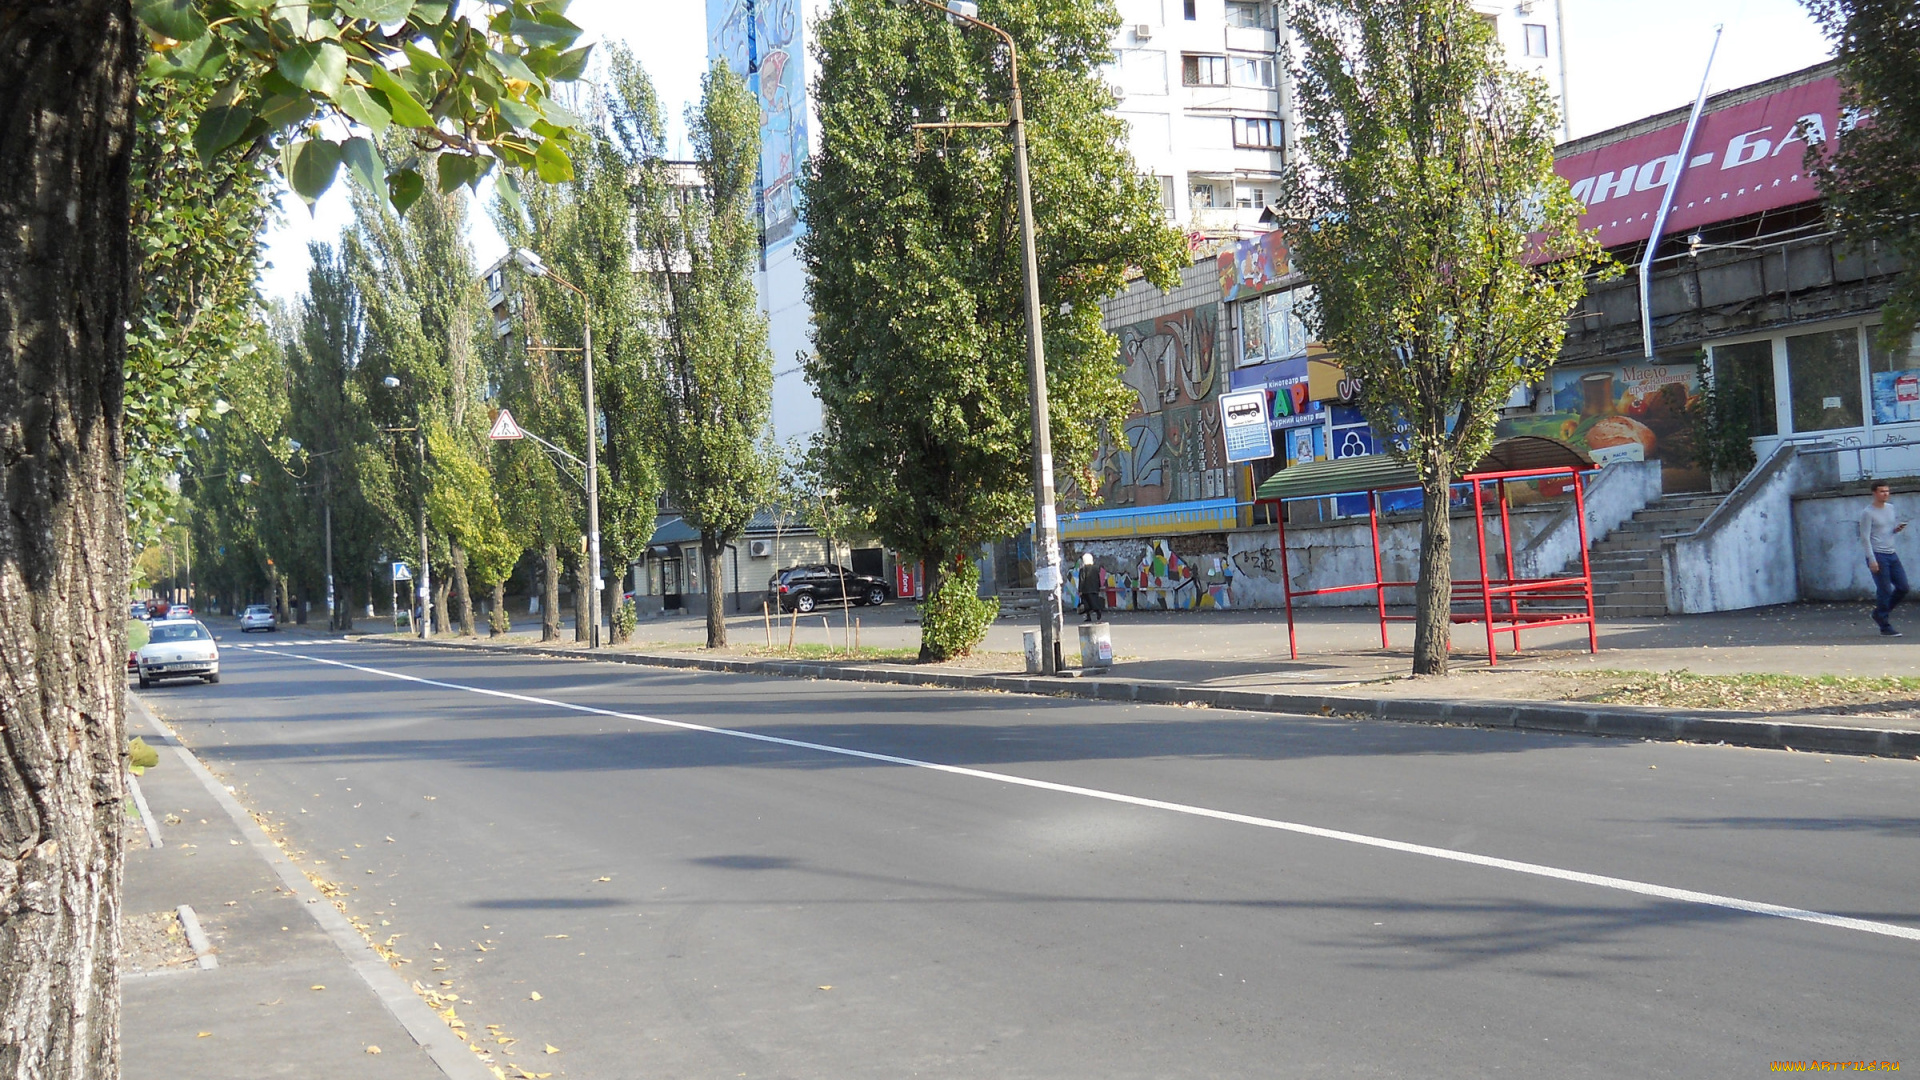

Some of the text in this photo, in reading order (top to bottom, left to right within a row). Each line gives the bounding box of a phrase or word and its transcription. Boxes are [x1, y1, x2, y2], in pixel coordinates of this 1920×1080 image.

[1622, 366, 1667, 381] Масло
[1630, 384, 1656, 395] проби
[1295, 414, 1314, 423] центр
